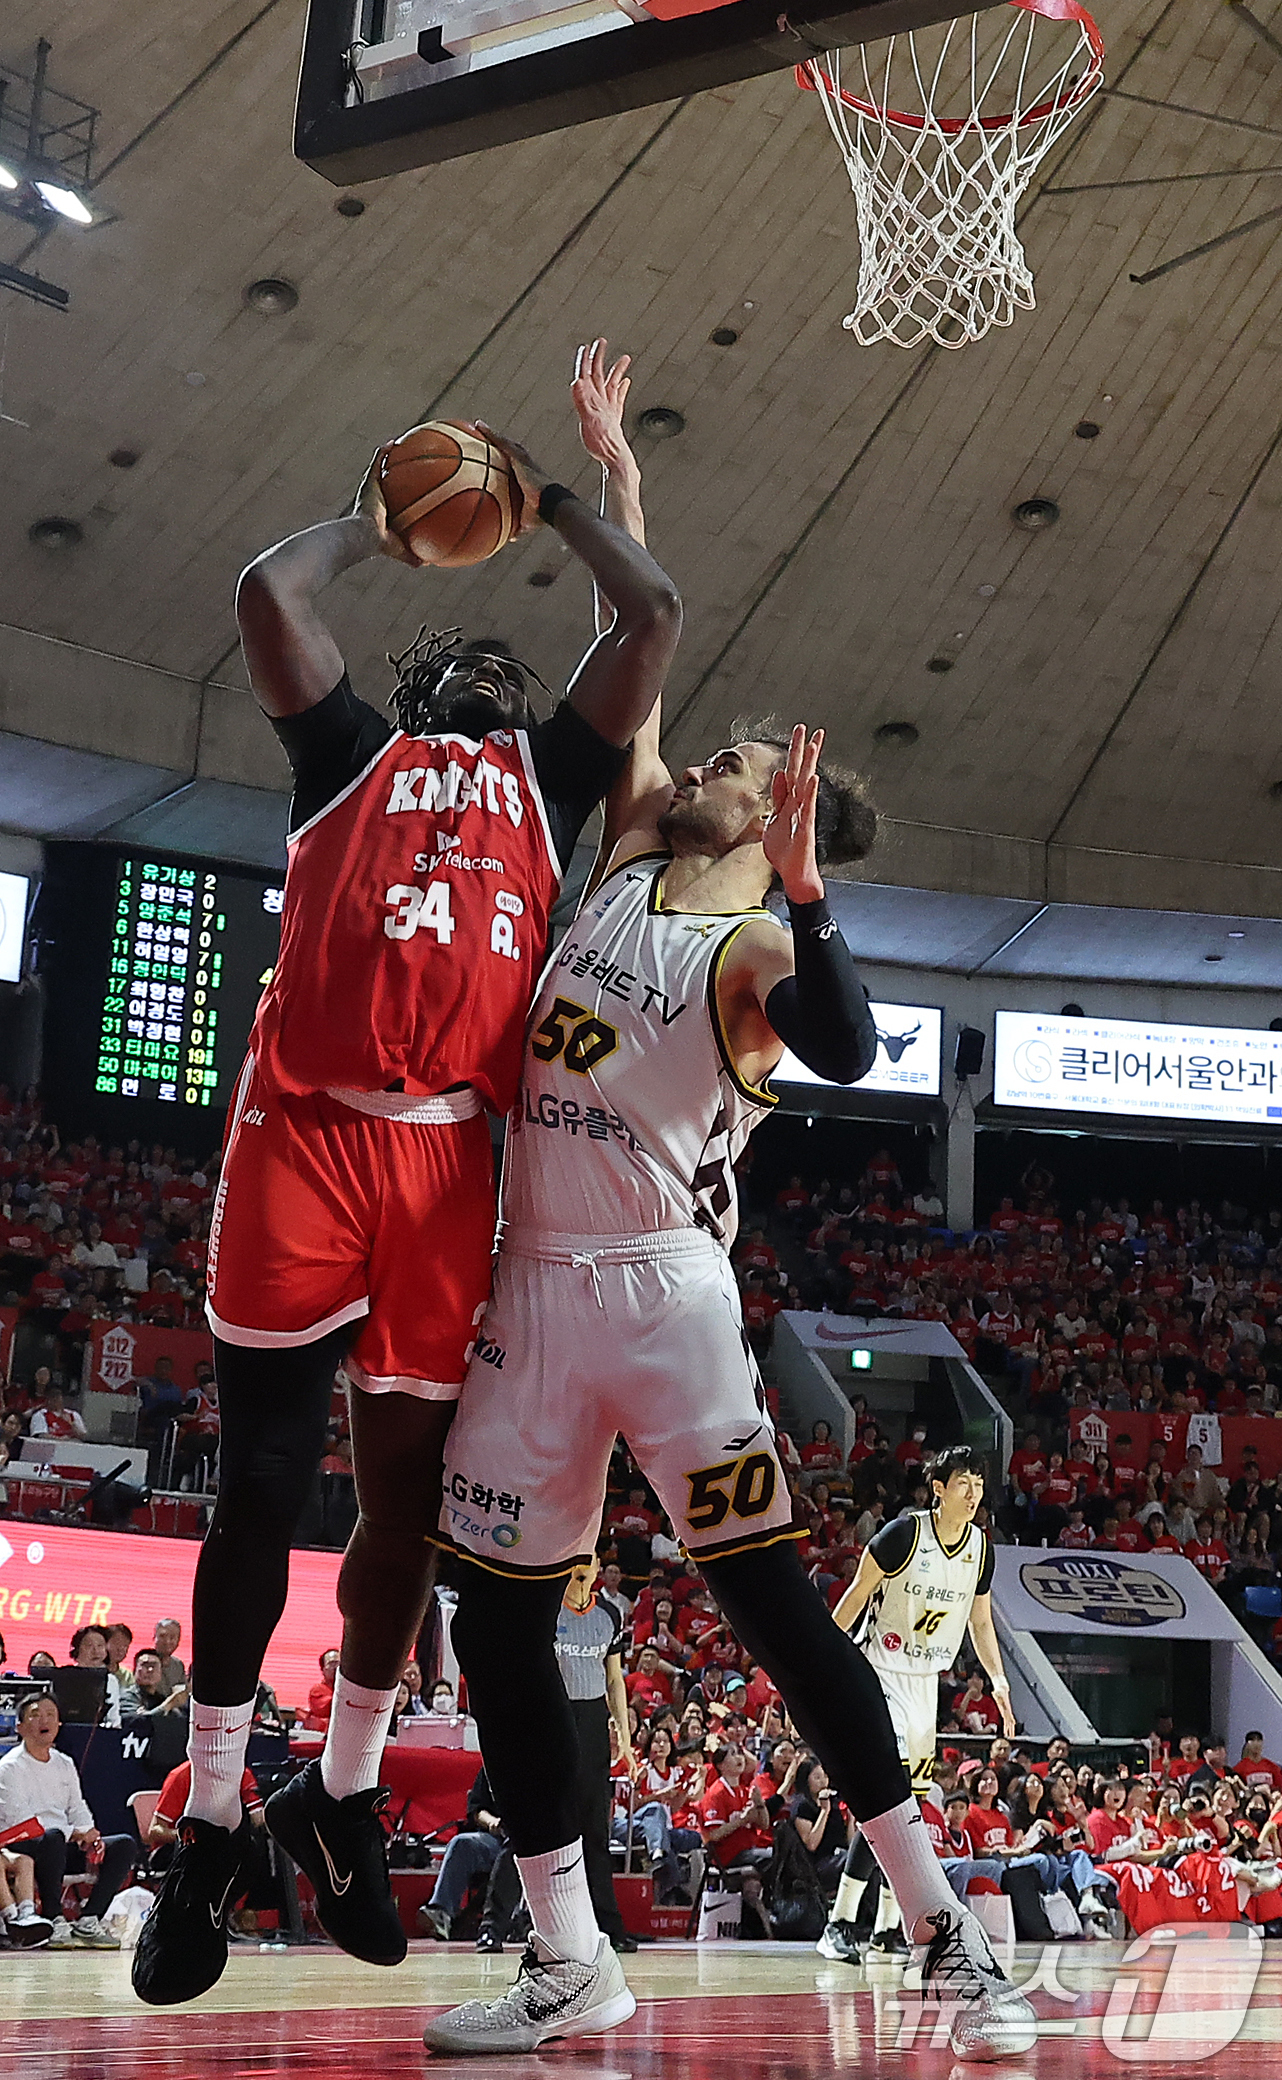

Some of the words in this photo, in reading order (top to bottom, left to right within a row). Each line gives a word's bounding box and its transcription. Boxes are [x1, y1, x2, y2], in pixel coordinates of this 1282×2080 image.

[124, 861, 132, 876] 1
[142, 863, 196, 887] 유기상
[204, 874, 217, 890] 2
[445, 850, 504, 874] telecom
[119, 881, 132, 896] 3
[140, 882, 195, 908] 장민국
[202, 893, 215, 910] 0
[117, 900, 130, 915] 5
[138, 902, 192, 925] 양준석
[201, 912, 214, 928] 7
[384, 880, 455, 944] 34
[115, 920, 128, 935] 6
[199, 931, 212, 948] 0
[111, 937, 129, 955] 11
[198, 951, 211, 967] 7
[110, 957, 129, 974] 16
[195, 970, 208, 987] 0
[107, 978, 128, 994] 17
[194, 989, 207, 1006] 0
[570, 949, 637, 1002] 올레드
[640, 984, 687, 1025] TV
[103, 996, 125, 1014] 22
[192, 1009, 205, 1025] 0
[101, 1016, 122, 1034] 31
[190, 1028, 203, 1046] 0
[532, 994, 620, 1078] 50
[99, 1036, 121, 1054] 33
[187, 1047, 206, 1065] 19
[97, 1056, 119, 1074] 50
[185, 1067, 204, 1085] 13
[1059, 1047, 1282, 1094] 클리어서울안과
[95, 1076, 117, 1093] 86
[185, 1087, 198, 1104] 0
[1163, 1425, 1174, 1442] 5
[1199, 1427, 1209, 1444] 5
[443, 1472, 525, 1522] G화학
[684, 1450, 779, 1533] 50
[903, 1581, 922, 1596] LG
[926, 1586, 955, 1602] 올레드
[1032, 1577, 1175, 1606] 프로틴
[913, 1609, 949, 1636] 16
